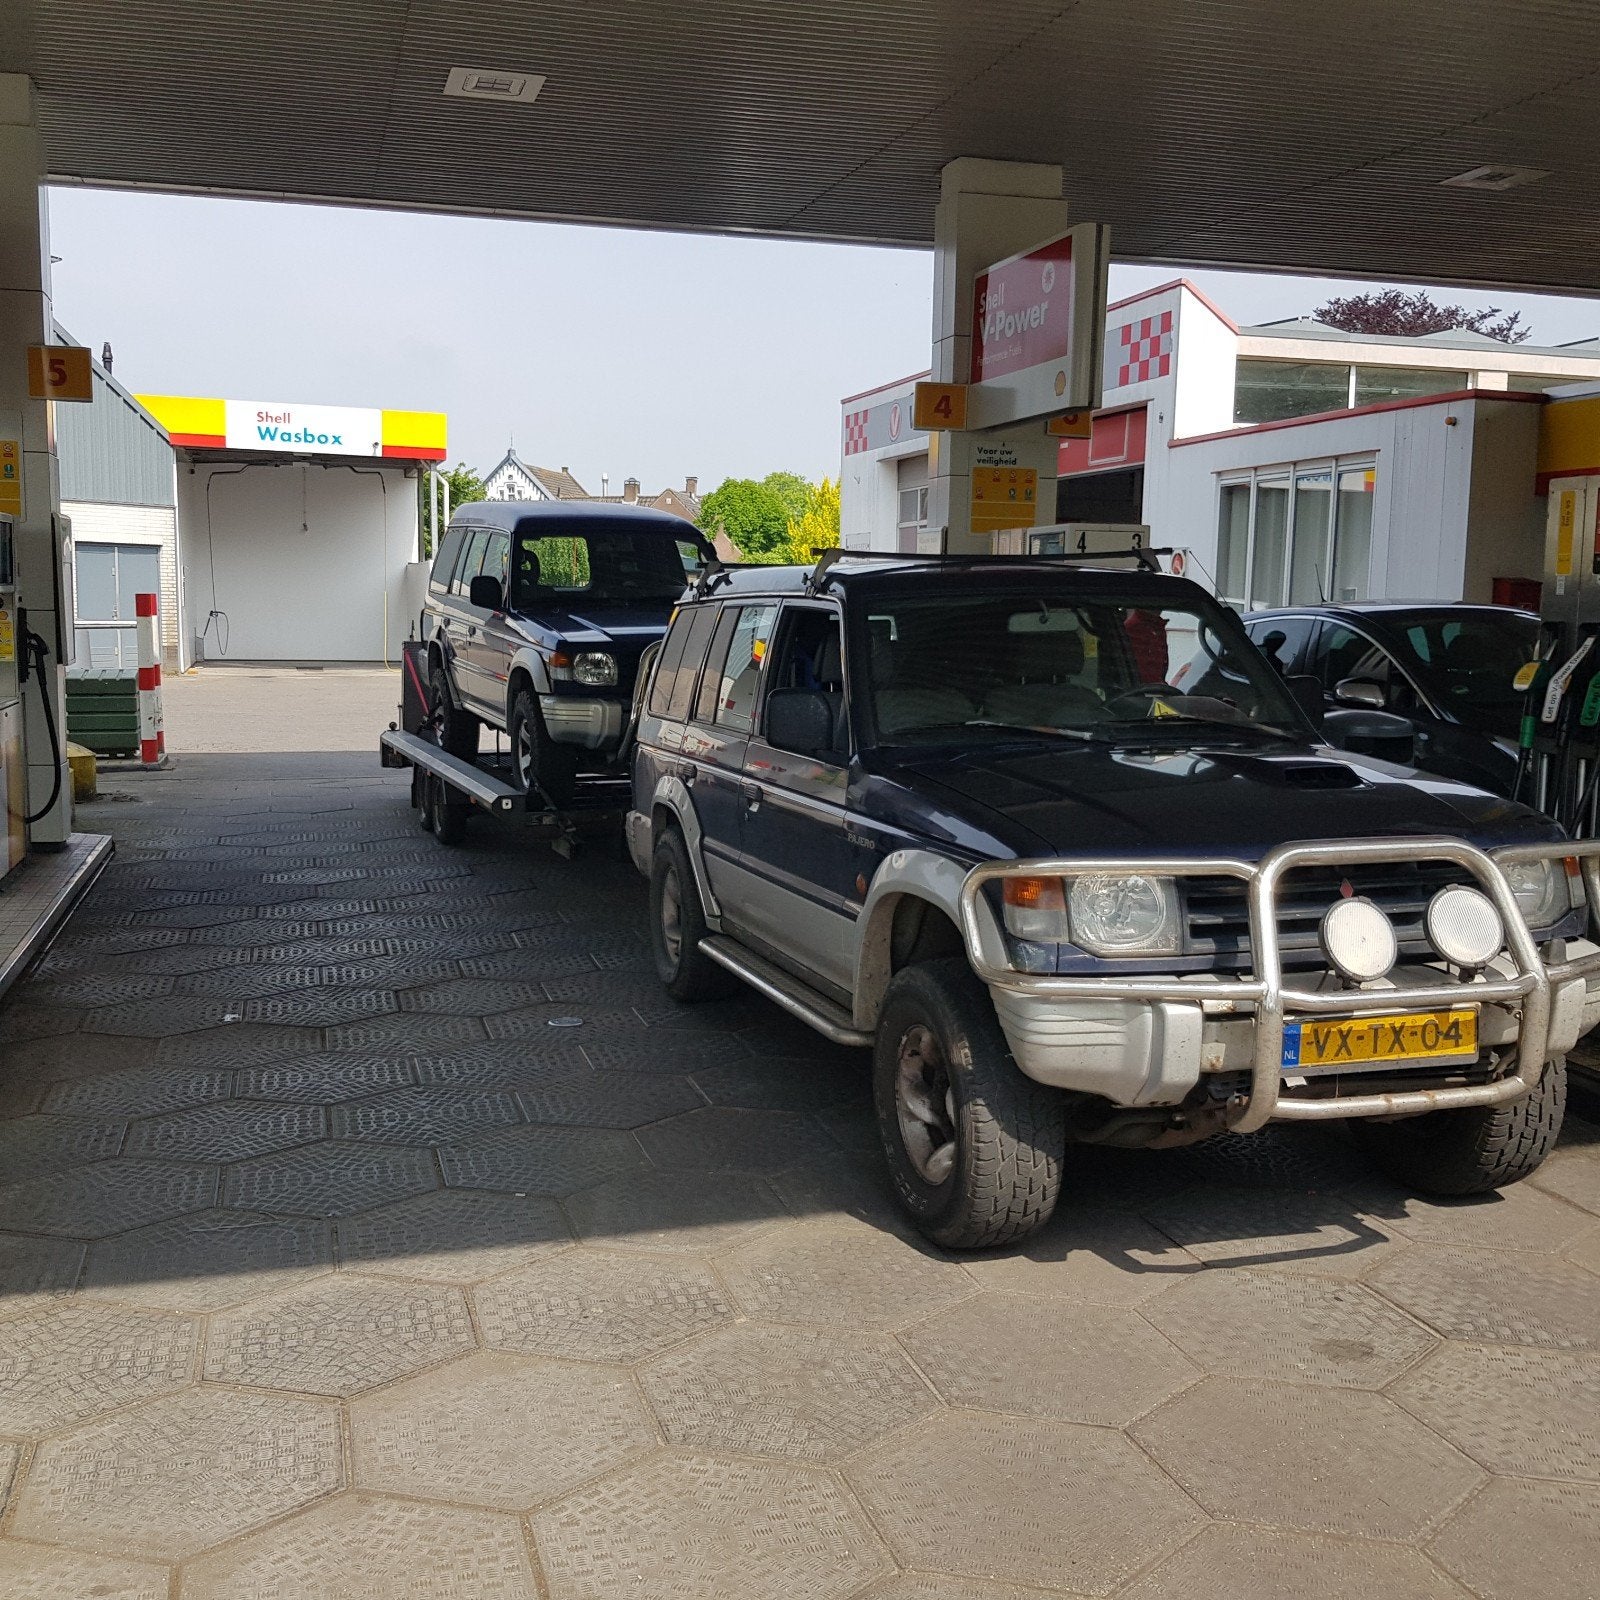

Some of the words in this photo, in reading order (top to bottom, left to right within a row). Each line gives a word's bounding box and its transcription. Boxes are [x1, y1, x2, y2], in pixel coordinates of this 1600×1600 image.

[979, 283, 1005, 313] Shell
[980, 301, 1048, 346] V-Power
[48, 358, 67, 386] 5
[934, 395, 952, 418] 4
[257, 411, 291, 424] Shell
[257, 426, 343, 445] Wasbox
[977, 447, 997, 455] Voor
[977, 457, 1017, 466] veiligheid
[1077, 531, 1087, 553] 4
[1132, 533, 1142, 550] 3
[1545, 706, 1555, 719] Let
[1312, 1018, 1463, 1059] VX-TX-04
[1284, 1051, 1297, 1060] NL
